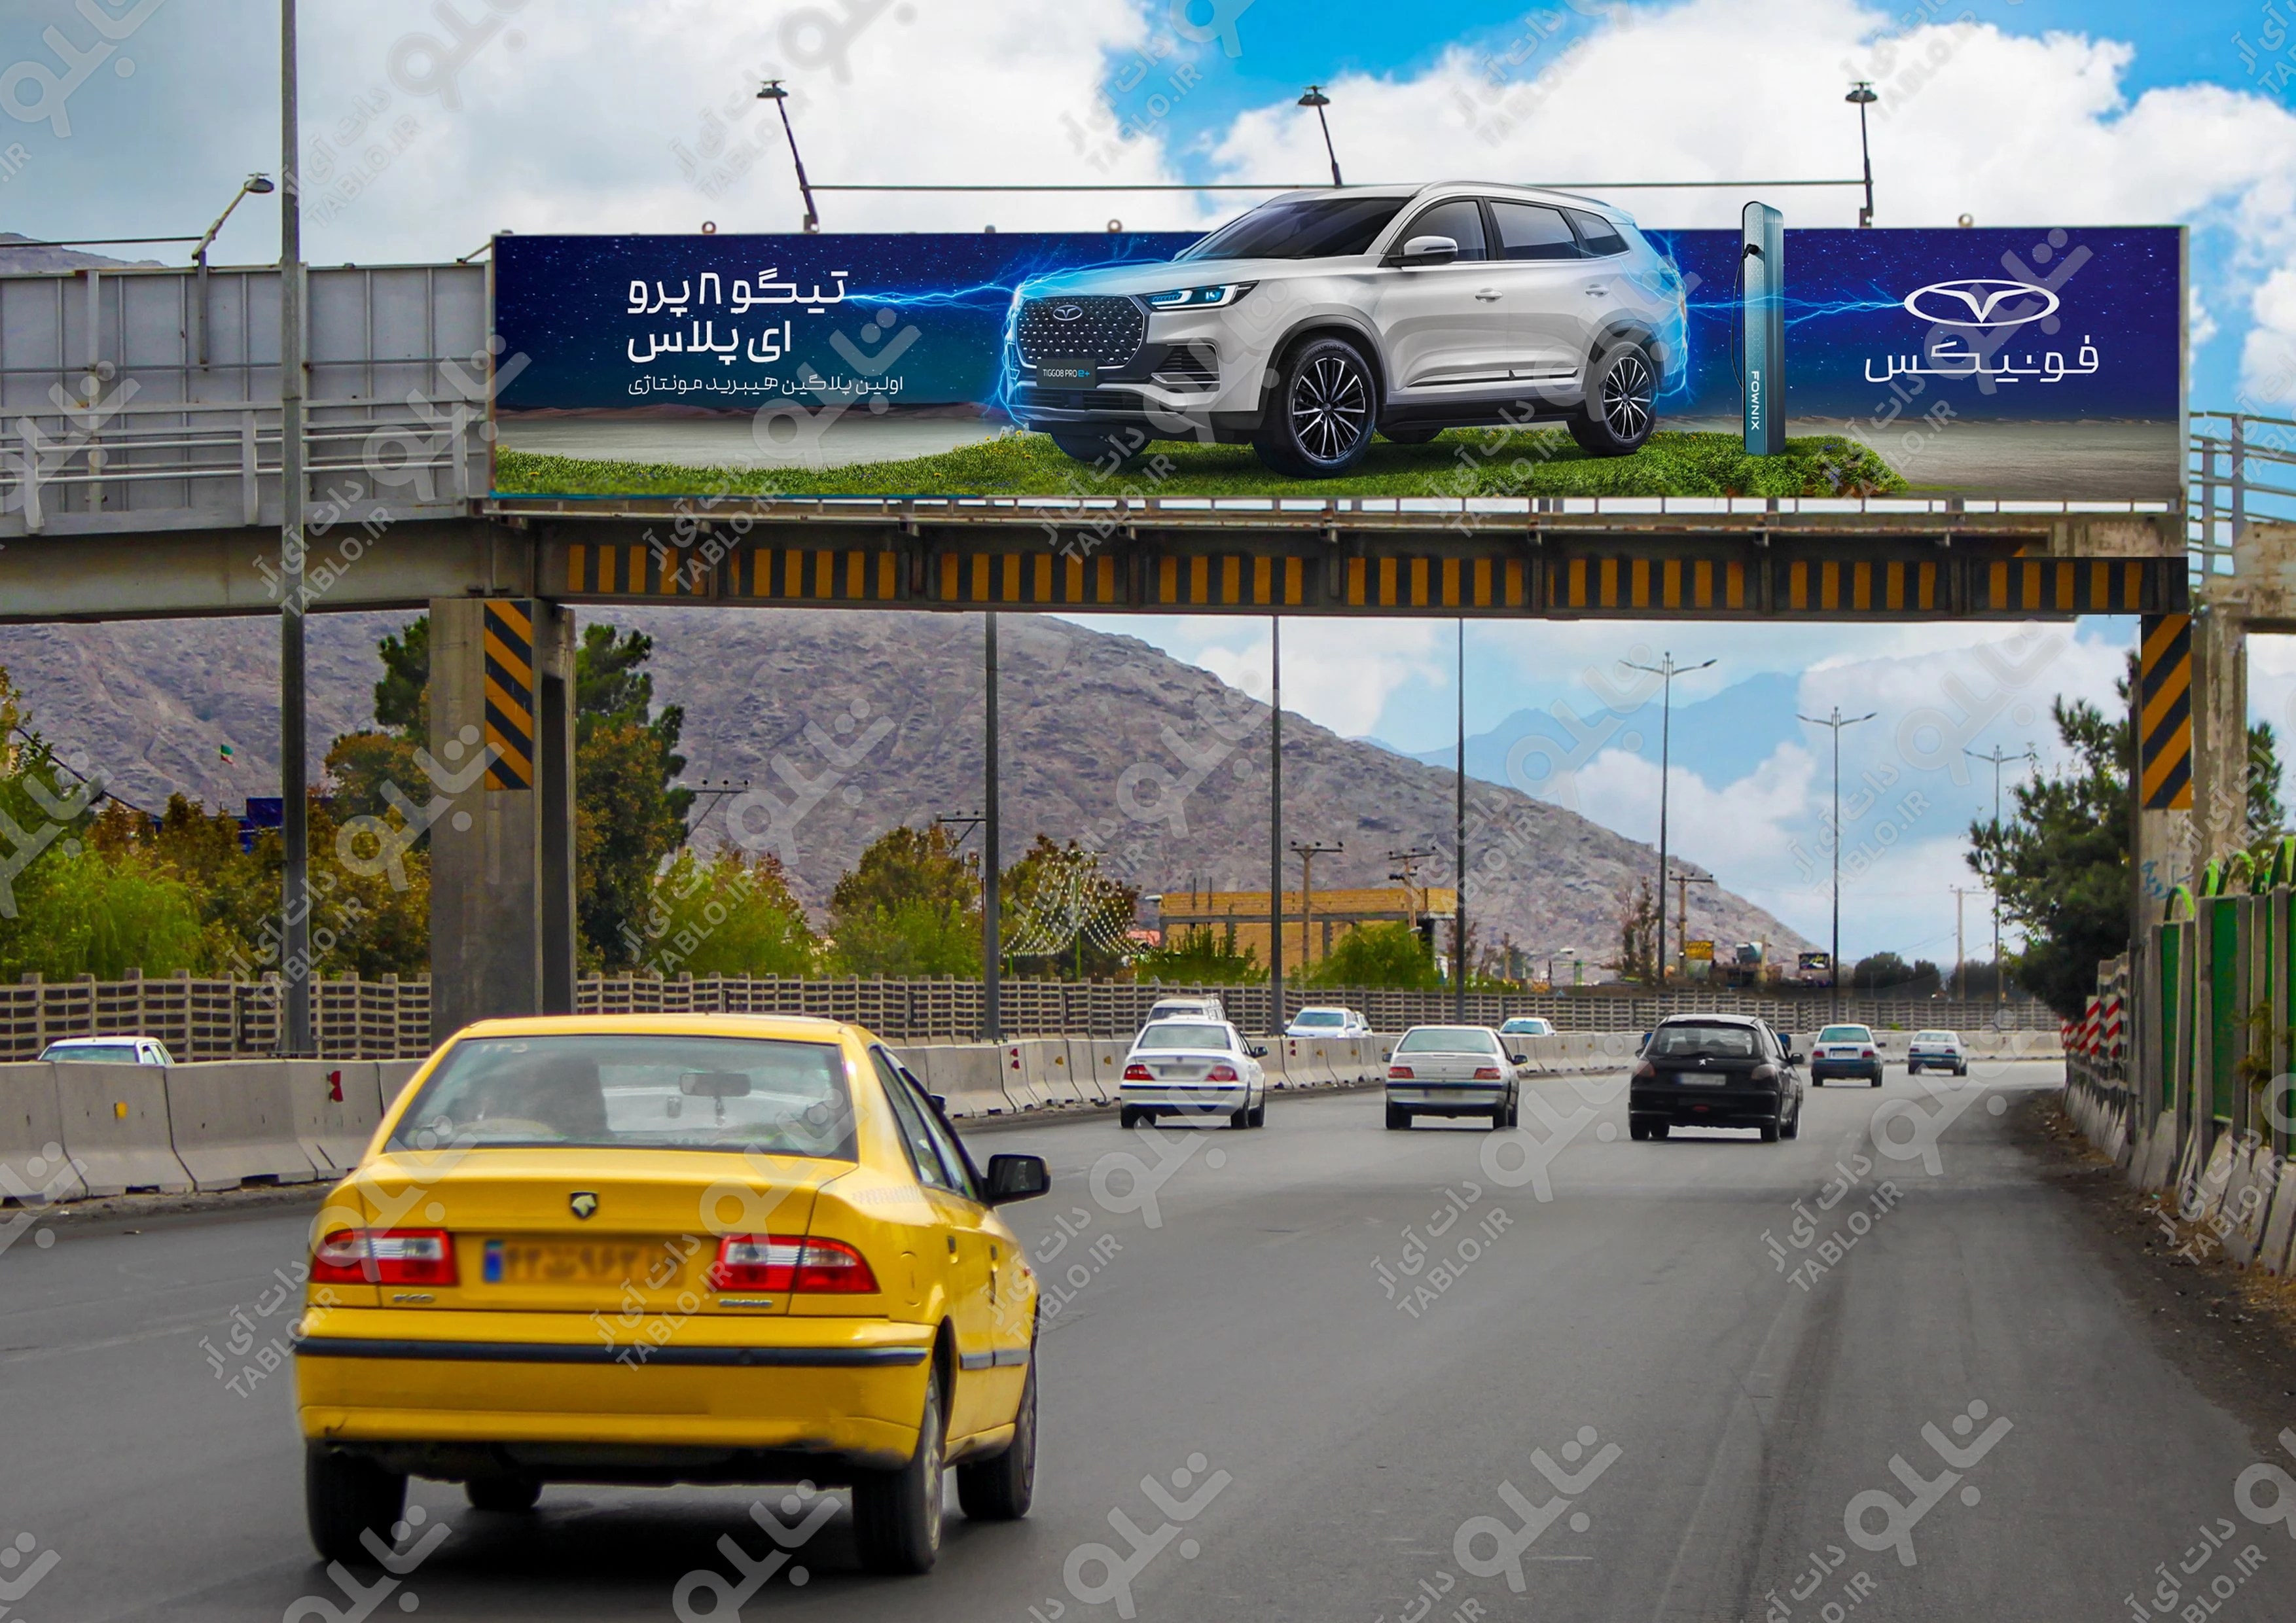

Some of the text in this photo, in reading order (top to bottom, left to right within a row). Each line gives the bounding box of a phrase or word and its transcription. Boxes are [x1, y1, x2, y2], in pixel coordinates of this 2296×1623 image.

[627, 279, 691, 317] پرو
[730, 267, 849, 314] تیگو
[627, 320, 791, 366] ای پلاس
[1864, 334, 2100, 383] فونیکس
[628, 373, 903, 396] اولین پلاگین هیبرید مونتاژی
[1065, 368, 1078, 378] PRO
[1751, 370, 1760, 431] FOWNIX
